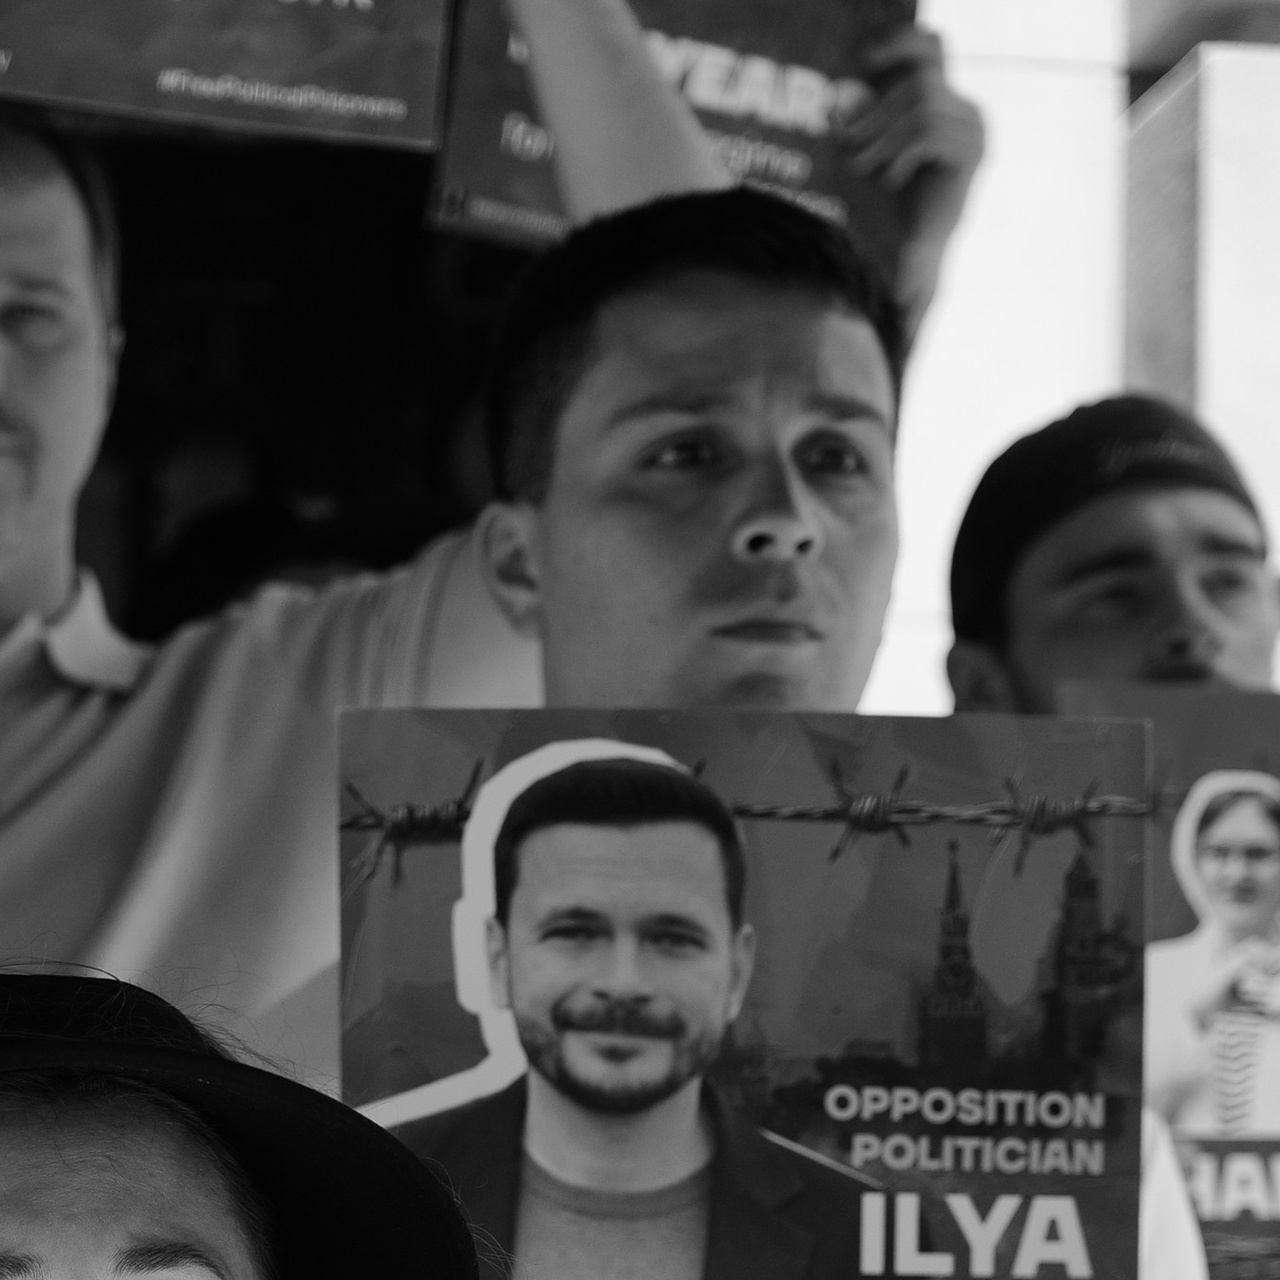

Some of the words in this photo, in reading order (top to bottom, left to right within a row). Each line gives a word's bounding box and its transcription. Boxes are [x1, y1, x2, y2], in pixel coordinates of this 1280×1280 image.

[823, 1084, 1107, 1129] OPPOSITION
[851, 1133, 1105, 1176] POLITICIAN
[860, 1191, 1093, 1280] ILYA
